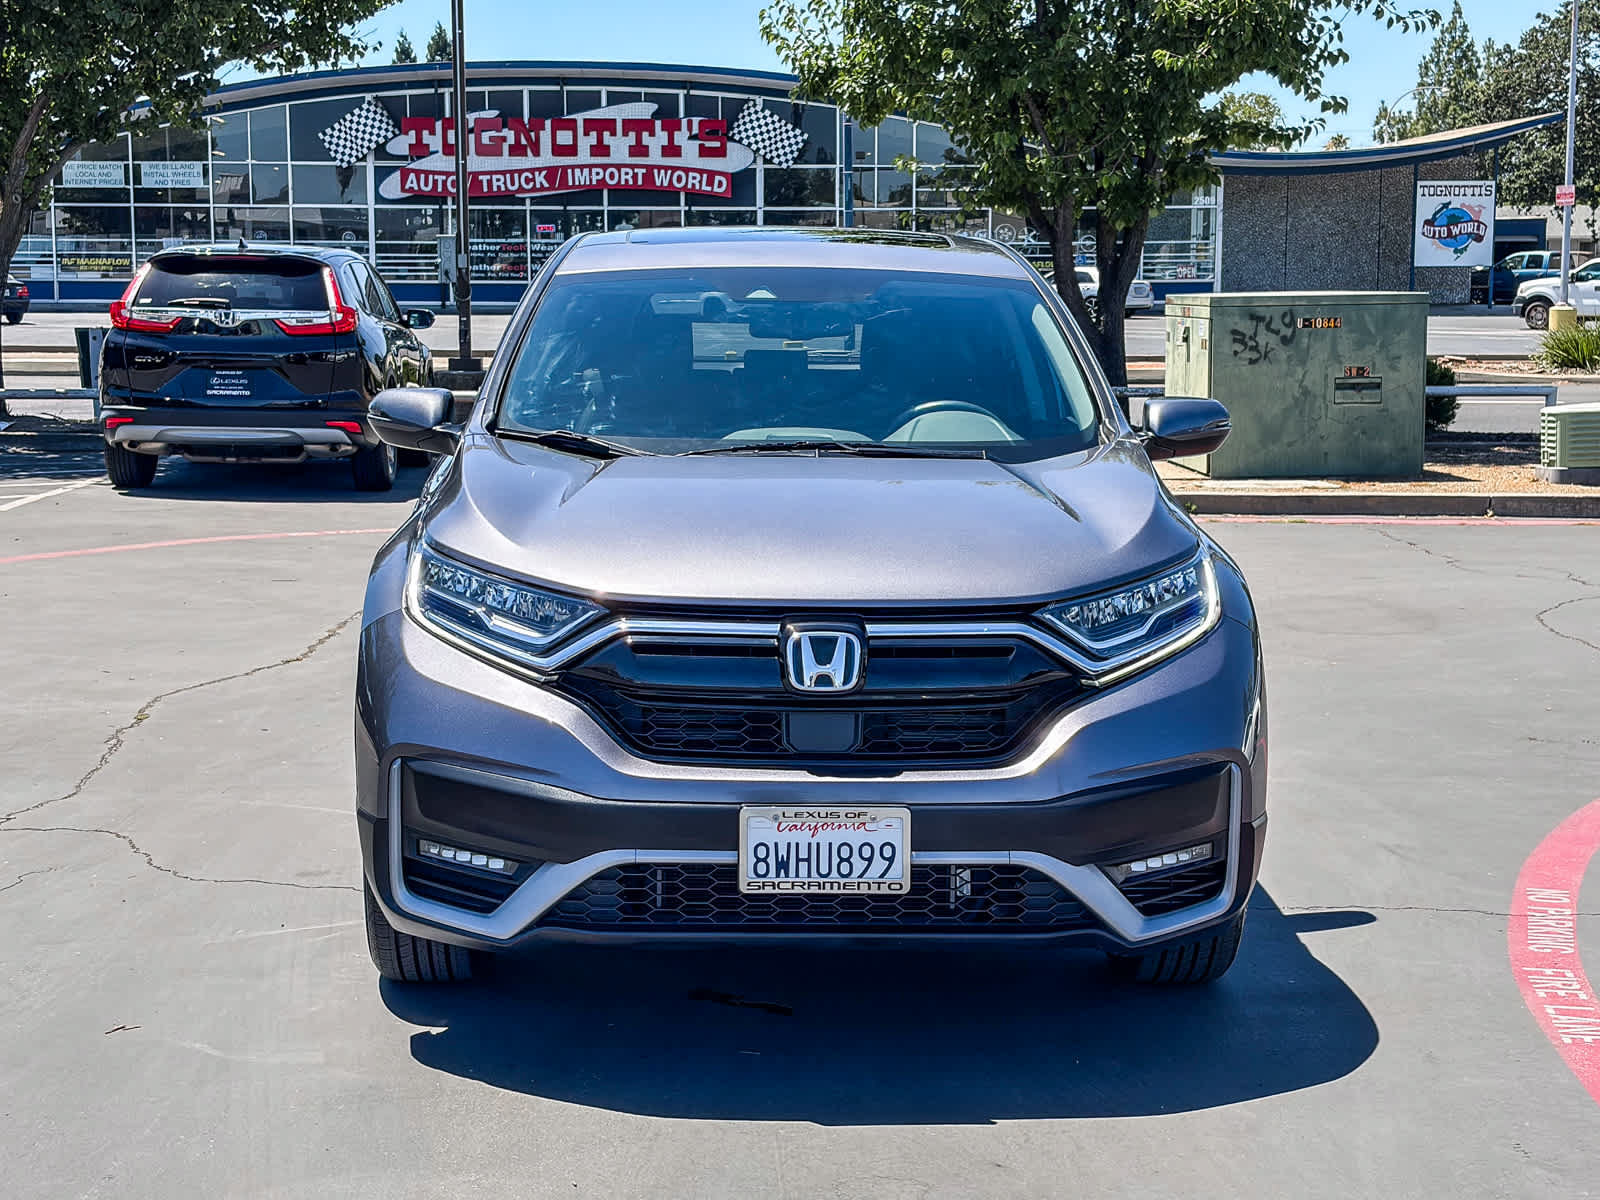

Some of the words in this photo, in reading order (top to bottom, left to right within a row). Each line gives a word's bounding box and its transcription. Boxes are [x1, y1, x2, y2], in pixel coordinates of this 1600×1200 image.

[401, 117, 728, 158] TOGNOTTI'S
[404, 172, 457, 193] AUTO
[478, 169, 550, 193] TRUCK
[567, 167, 647, 186] IMPORT
[653, 168, 728, 193] WORLD
[1419, 182, 1493, 197] TOGNOTTI'S
[1423, 224, 1448, 238] AUTO
[1450, 222, 1485, 236] WORLD
[1176, 266, 1197, 279] OPEN
[1297, 317, 1342, 328] U-10844
[1344, 366, 1370, 377] SW-2
[782, 811, 841, 819] LEXUS
[844, 811, 869, 819] OF
[776, 821, 878, 838] California
[753, 841, 897, 879] 8WHU899
[746, 881, 903, 891] SACRAMENTO
[1525, 887, 1571, 903] NO
[1527, 905, 1575, 954] PARKING
[1522, 967, 1589, 1000] FIRE
